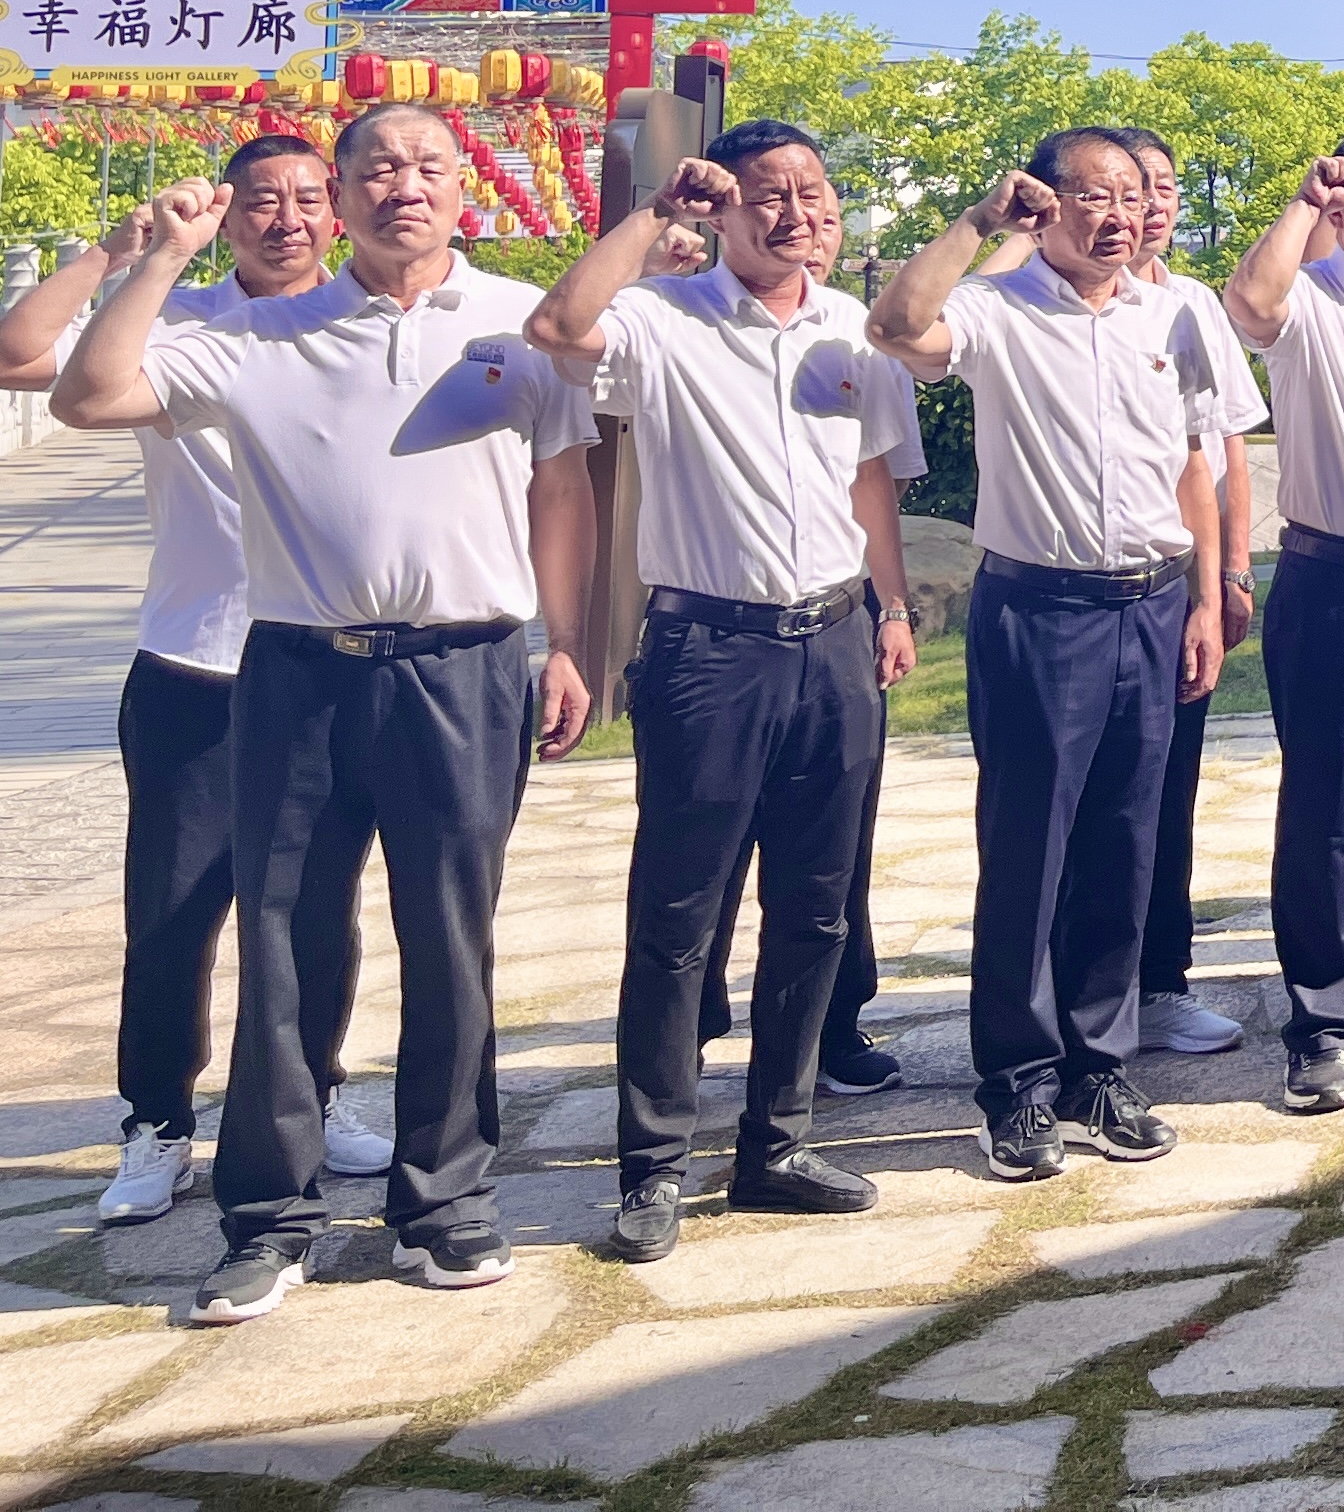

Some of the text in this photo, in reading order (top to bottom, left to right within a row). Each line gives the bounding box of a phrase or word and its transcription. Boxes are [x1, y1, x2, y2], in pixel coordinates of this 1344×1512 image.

[71, 71, 239, 81] HAPPINESS LIGHT GALLERY
